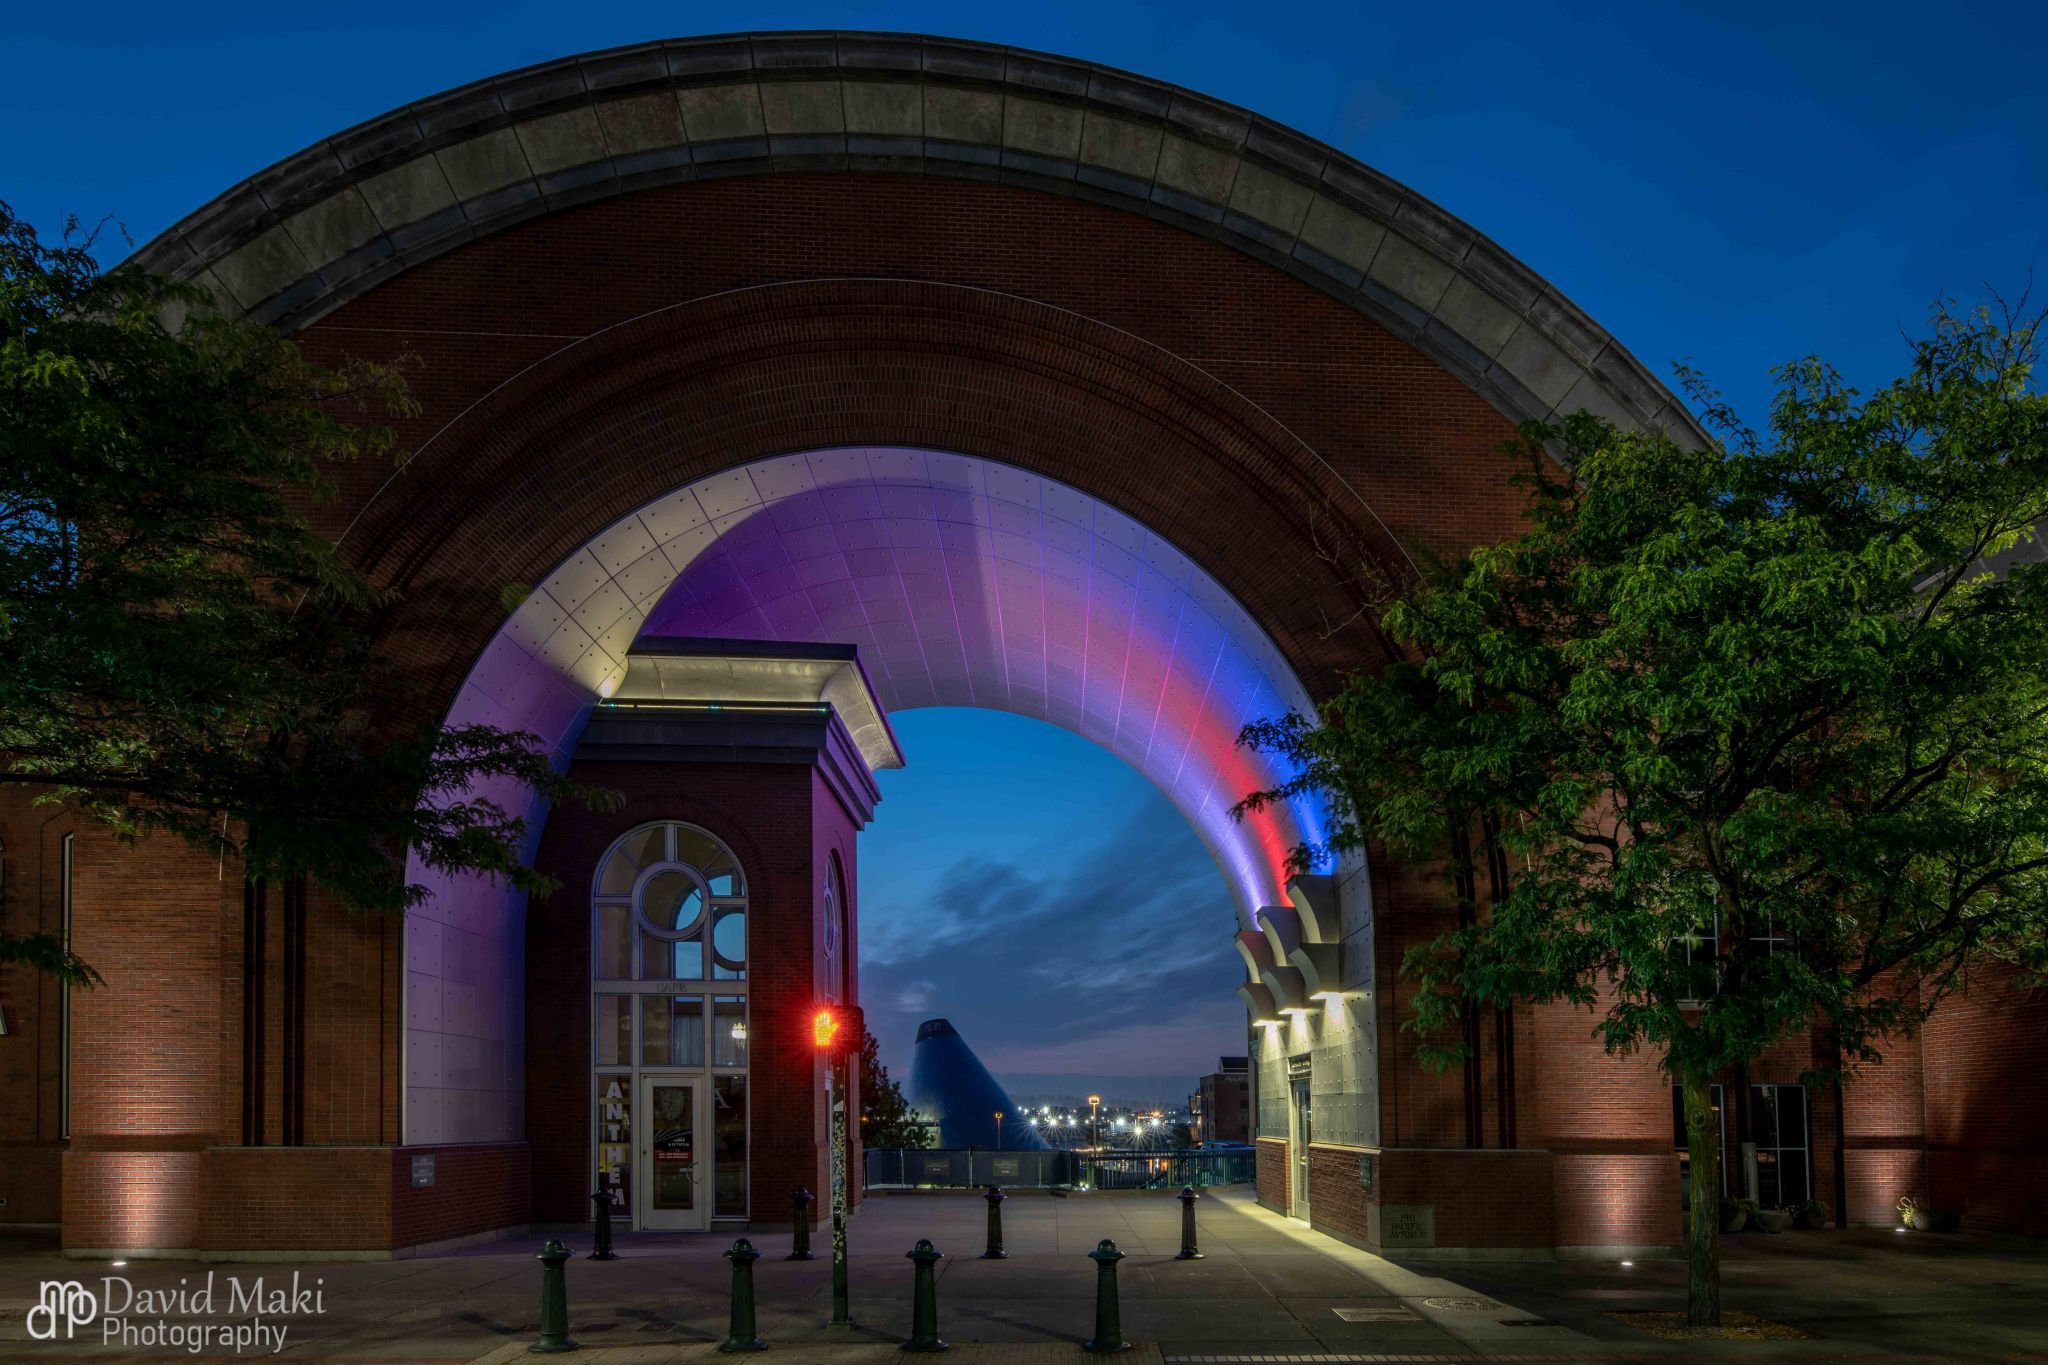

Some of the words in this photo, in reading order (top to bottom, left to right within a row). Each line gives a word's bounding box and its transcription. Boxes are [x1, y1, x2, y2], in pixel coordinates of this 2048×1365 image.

[656, 983, 688, 993] CAFE
[606, 1081, 625, 1205] ANTHEM
[1400, 1214, 1416, 1222] 1911
[1391, 1222, 1426, 1231] PACIFIC
[1390, 1231, 1428, 1239] AVENUE
